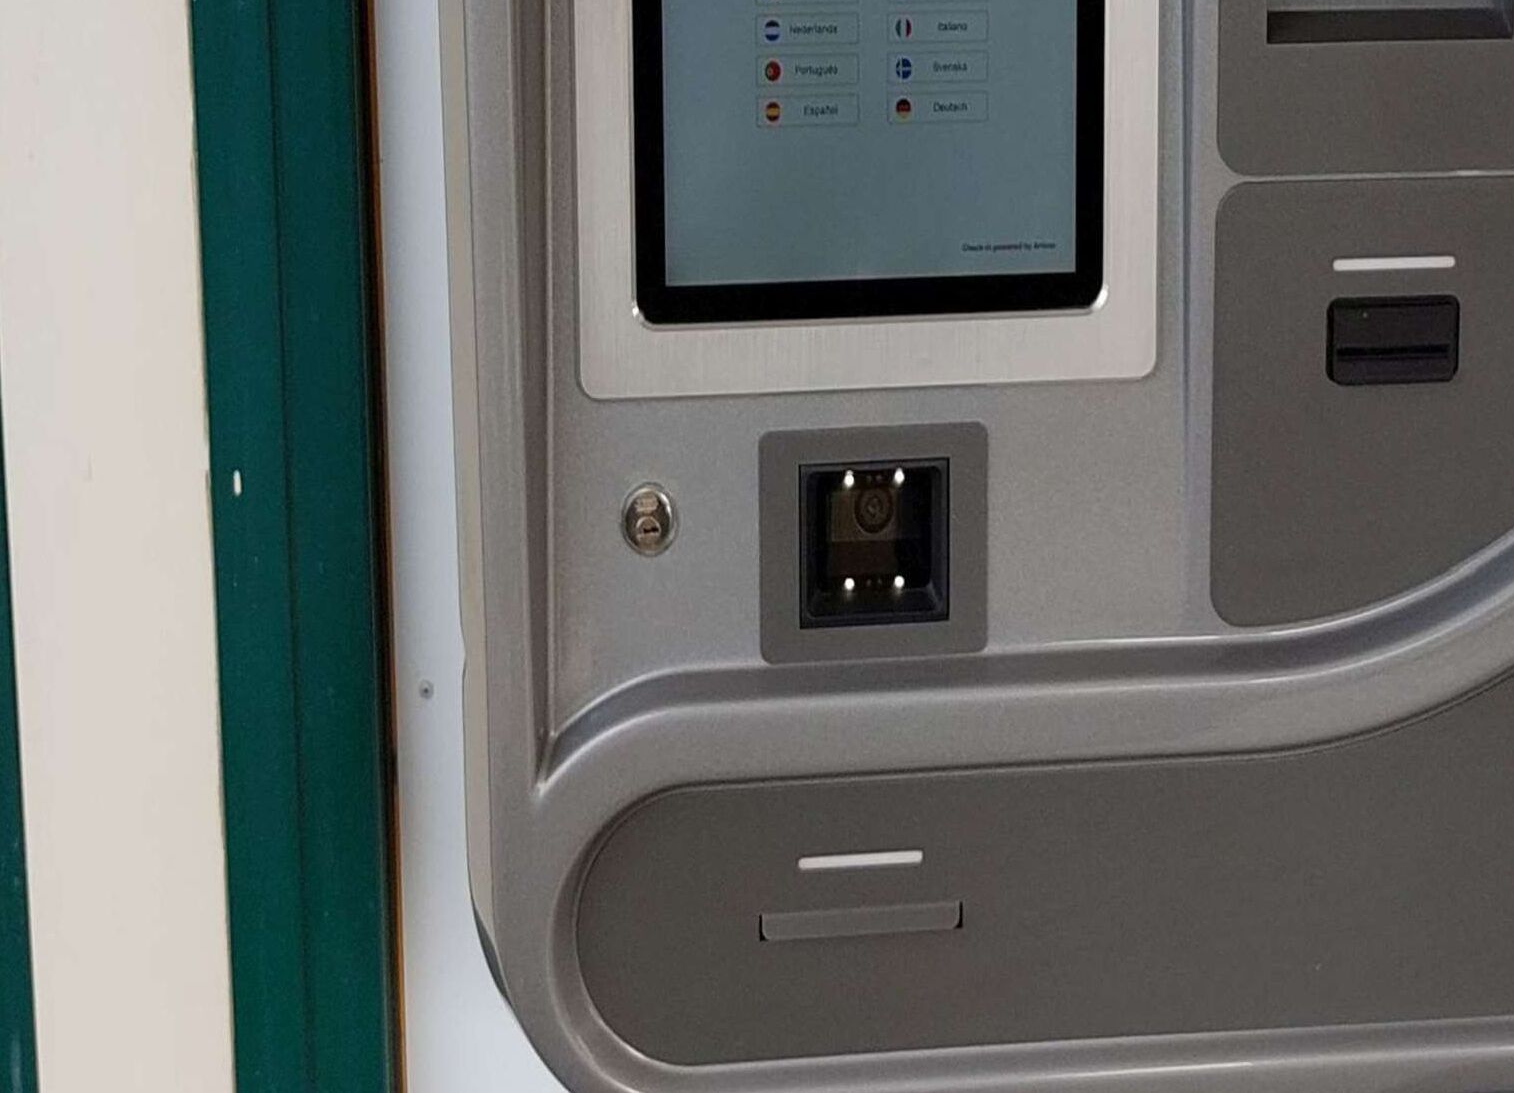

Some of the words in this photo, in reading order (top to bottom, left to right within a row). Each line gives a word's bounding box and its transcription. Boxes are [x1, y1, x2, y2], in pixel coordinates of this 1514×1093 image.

[938, 21, 968, 32] Italiano
[932, 60, 967, 73] Svenska
[803, 106, 838, 119] Español
[933, 102, 968, 114] Deutsch
